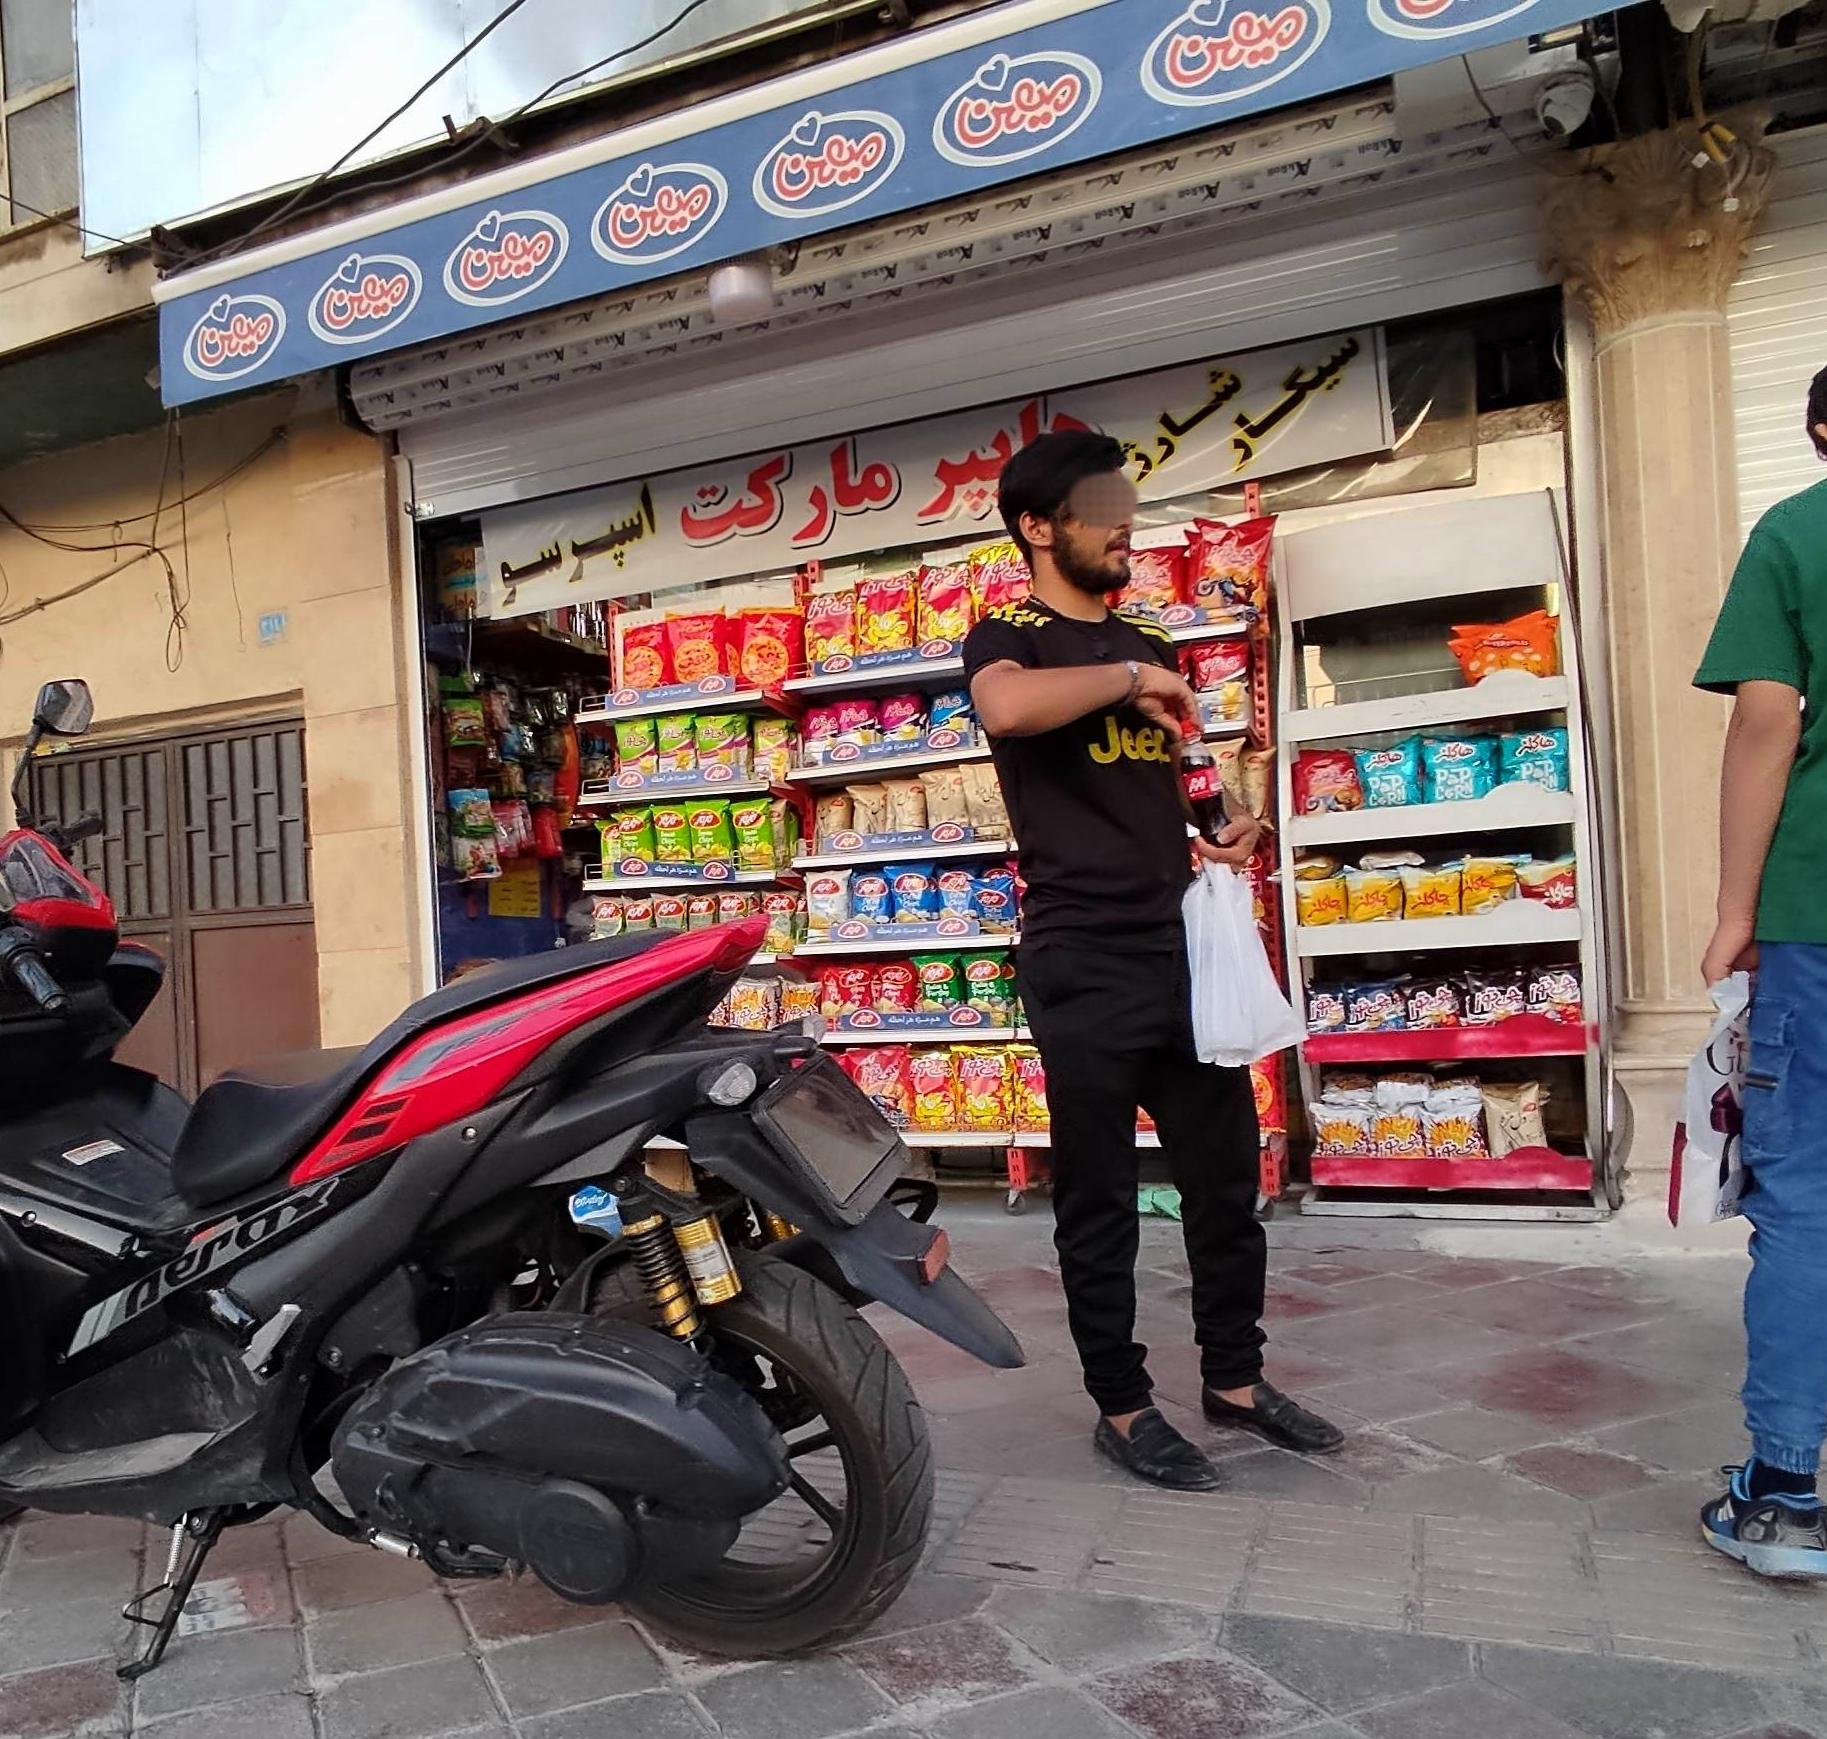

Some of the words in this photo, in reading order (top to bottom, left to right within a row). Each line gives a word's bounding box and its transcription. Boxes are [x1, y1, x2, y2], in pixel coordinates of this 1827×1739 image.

[1163, 6, 1305, 84] میهن
[956, 73, 1081, 146] میهن
[773, 131, 886, 200] میهن
[608, 184, 711, 248] میهن
[460, 231, 554, 291] میهن
[323, 274, 409, 330] میهن
[198, 312, 273, 367] میهن
[680, 440, 897, 546] مارکت
[499, 482, 656, 607] اسپرسو
